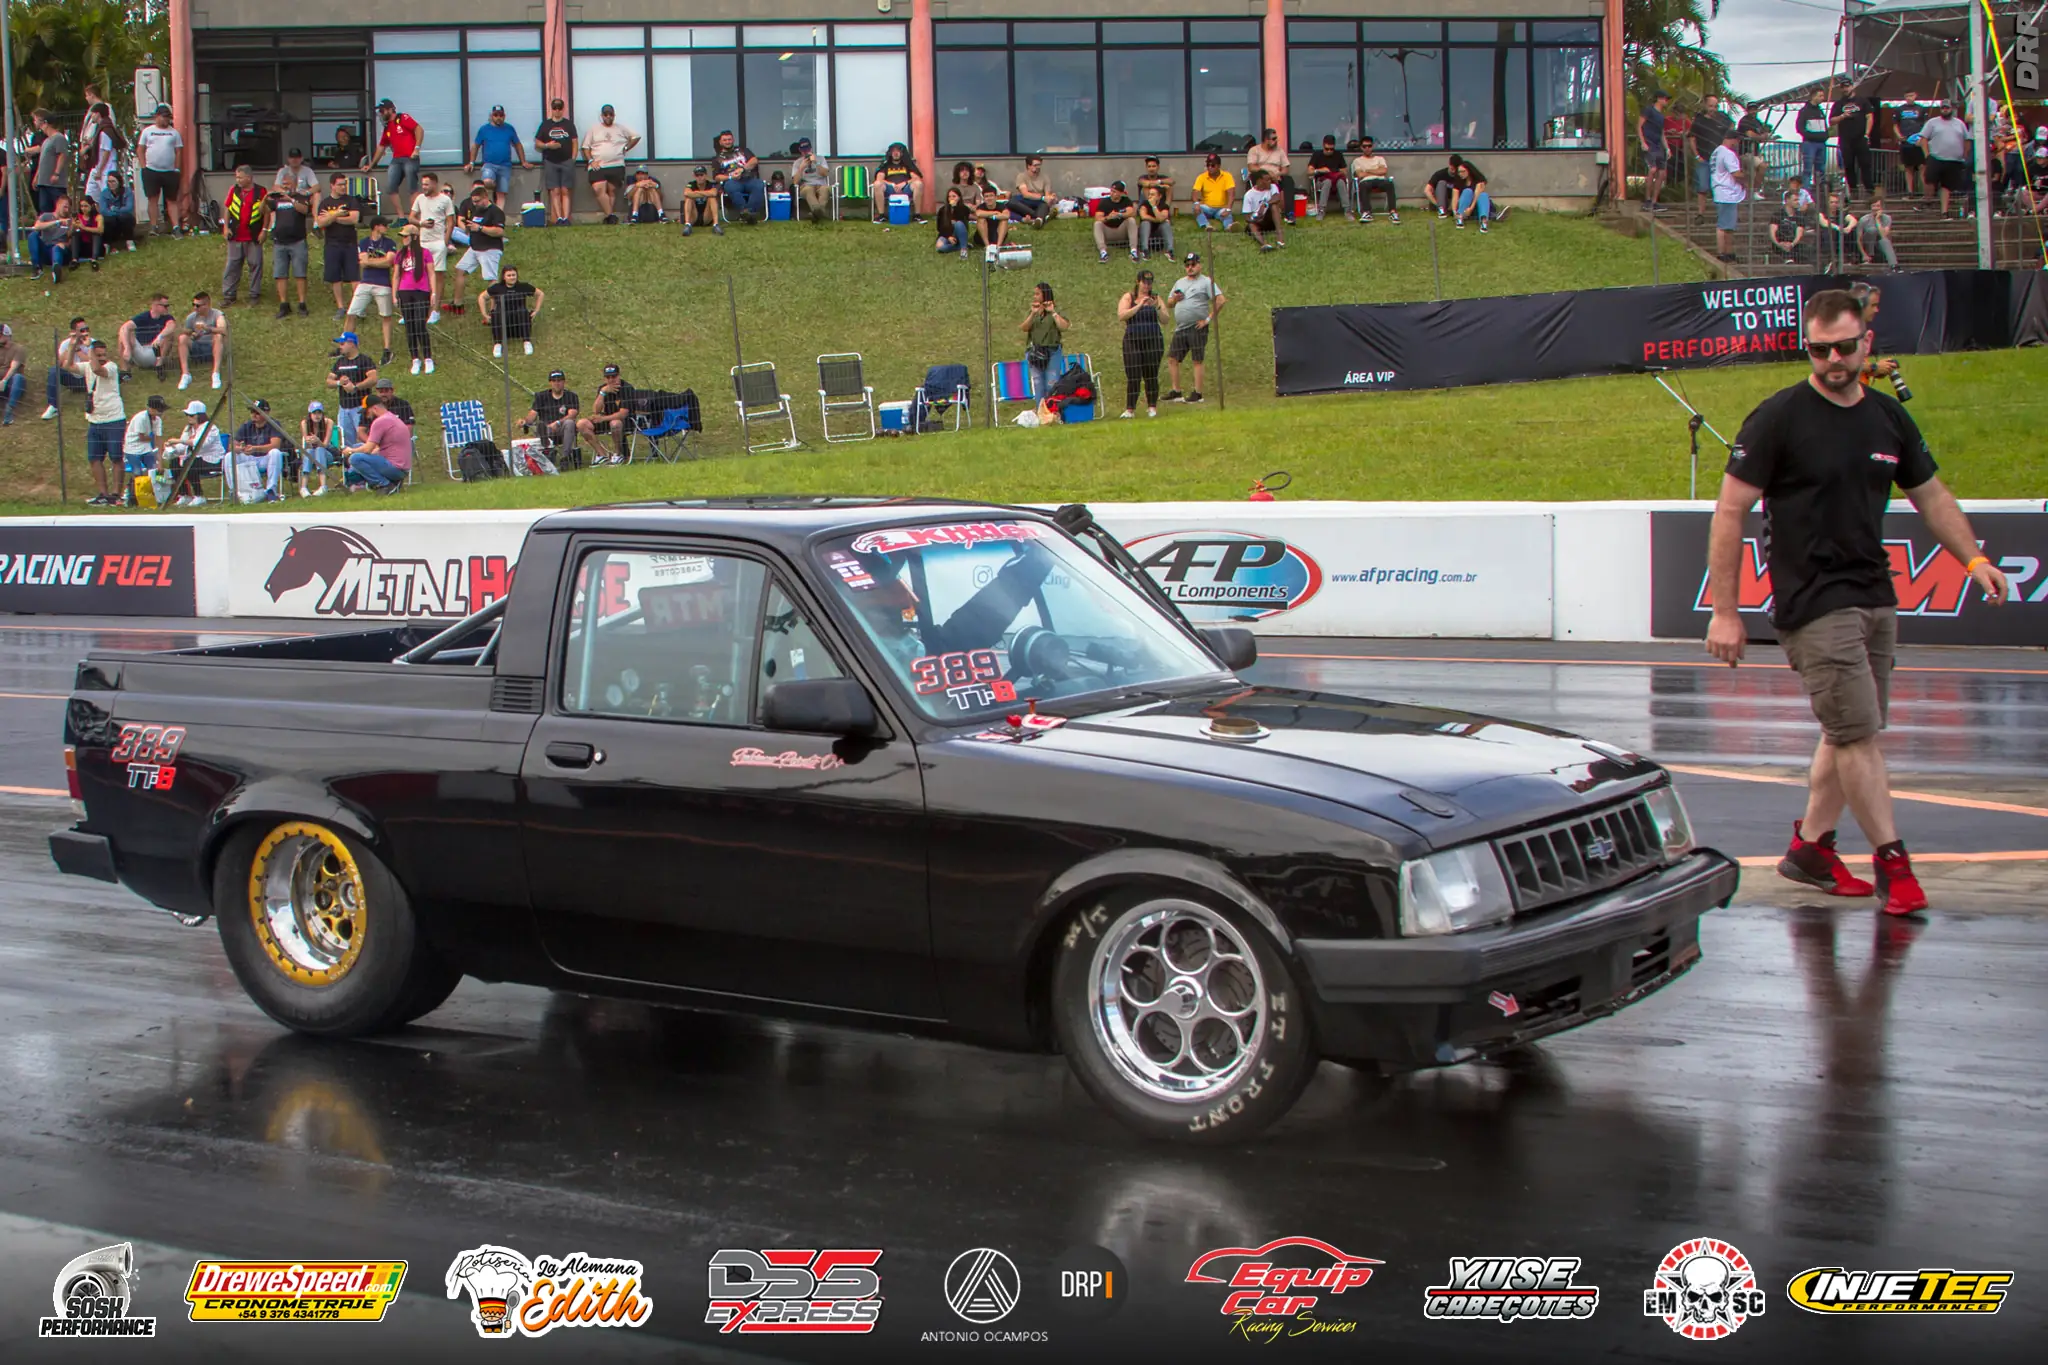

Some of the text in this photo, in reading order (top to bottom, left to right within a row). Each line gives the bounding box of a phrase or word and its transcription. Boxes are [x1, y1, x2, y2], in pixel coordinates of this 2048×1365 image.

[1703, 285, 1796, 309] WELCOME
[1731, 309, 1797, 330] TO THE
[1643, 331, 1798, 361] PERFORMANCE
[1344, 370, 1395, 385] ÁREA VIP
[97, 555, 173, 587] FUEL
[1331, 566, 1478, 585] www.afpracing.com.br
[1178, 583, 1288, 600] Components
[910, 648, 1002, 694] 389
[110, 723, 187, 764] 389
[1189, 1058, 1275, 1132] FRONT
